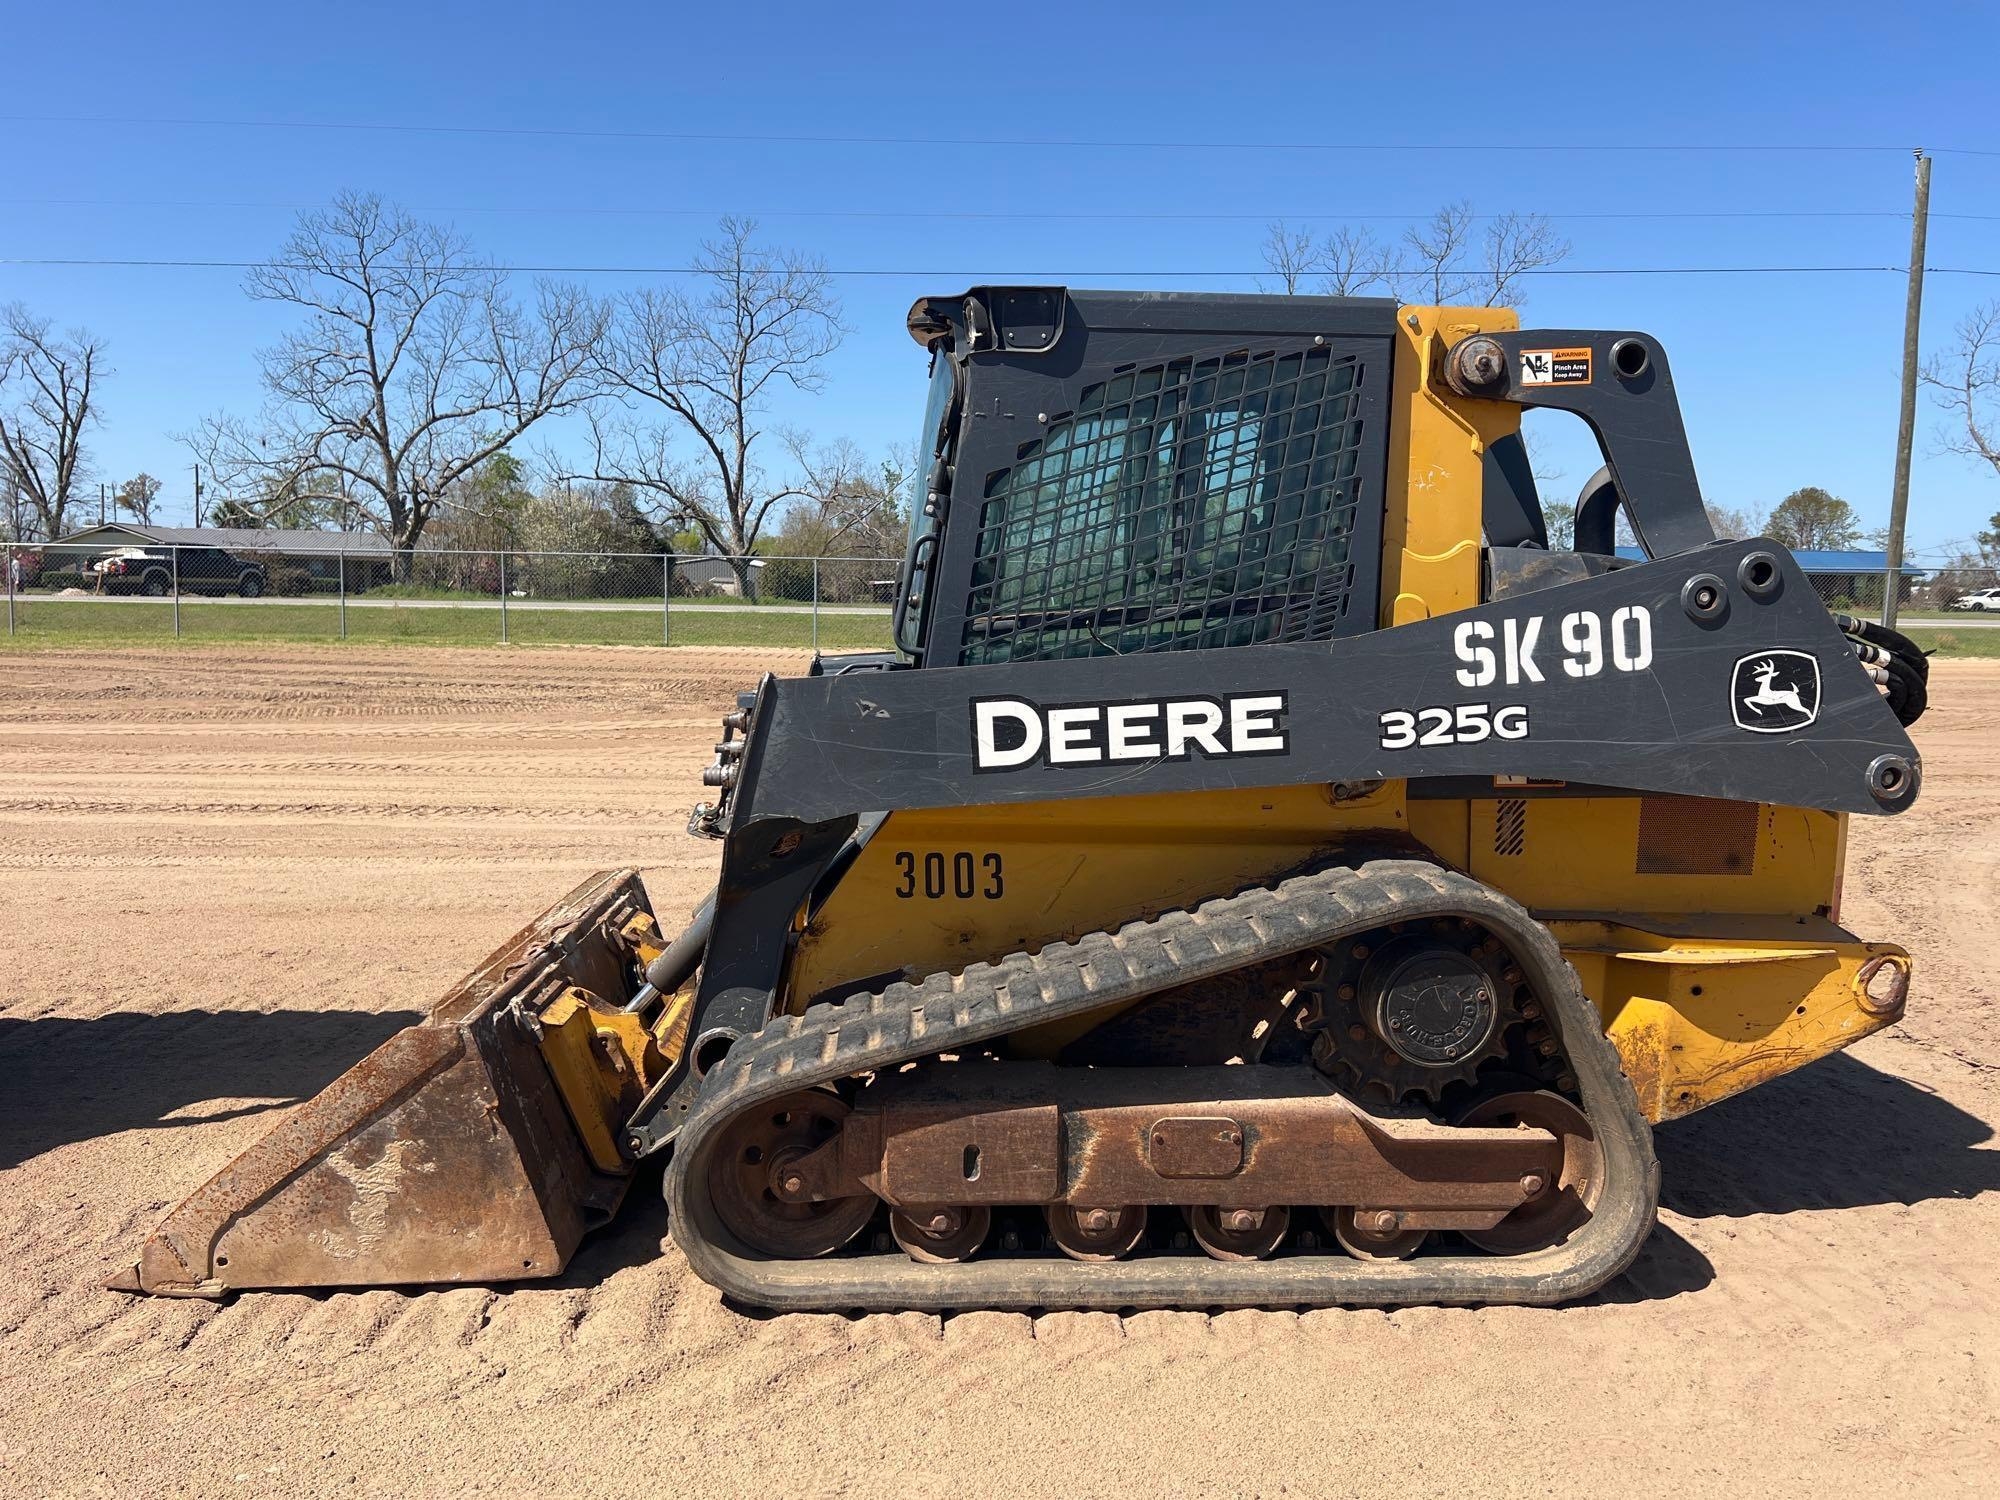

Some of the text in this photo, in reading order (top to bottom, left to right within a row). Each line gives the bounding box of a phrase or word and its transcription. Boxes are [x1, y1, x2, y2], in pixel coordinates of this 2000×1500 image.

[975, 695, 1285, 768] DEERE
[1380, 704, 1528, 749] 325G
[895, 851, 1004, 899] 3003
